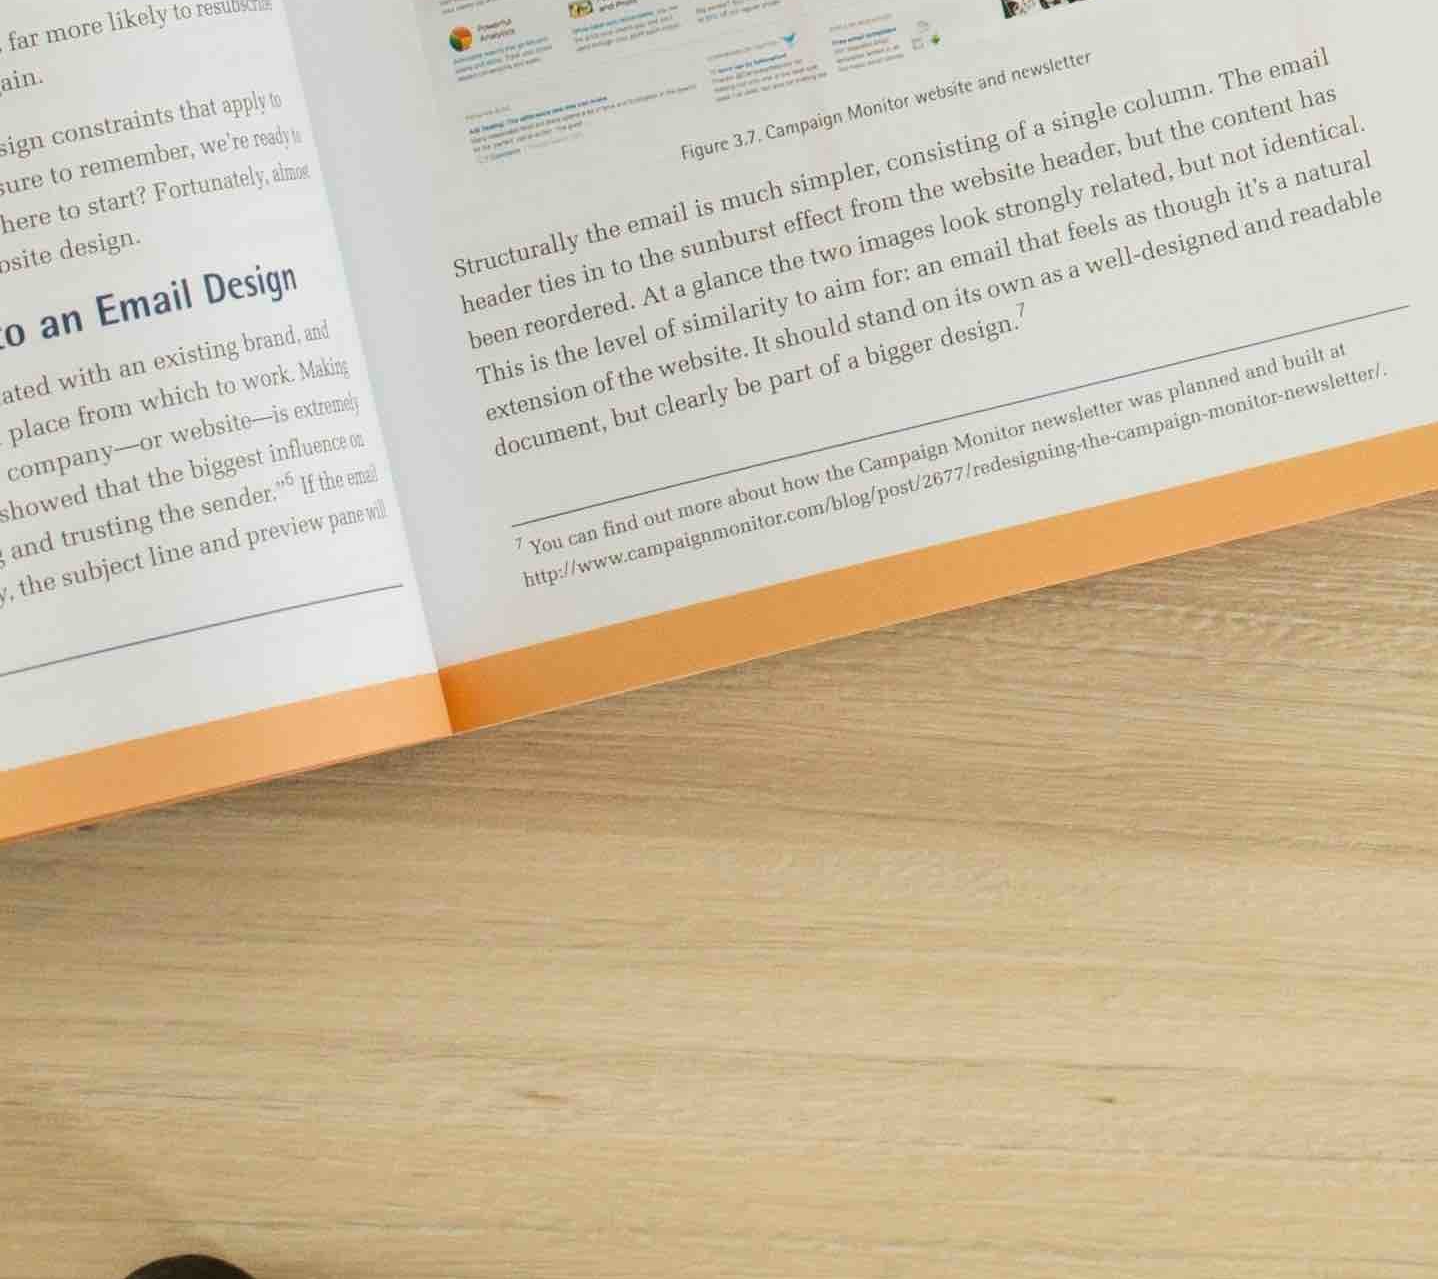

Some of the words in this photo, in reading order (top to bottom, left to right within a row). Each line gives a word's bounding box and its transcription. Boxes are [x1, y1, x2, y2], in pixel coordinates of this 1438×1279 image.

[680, 139, 729, 161] Figure
[732, 129, 763, 148] 3.7.
[764, 112, 843, 140] Campaign
[847, 95, 909, 121] Monitor
[913, 79, 974, 105] website
[977, 69, 1007, 90] and
[1010, 52, 1091, 82] newsletter
[39, 309, 83, 340] an
[95, 277, 193, 327] Email
[202, 263, 297, 305] Design
